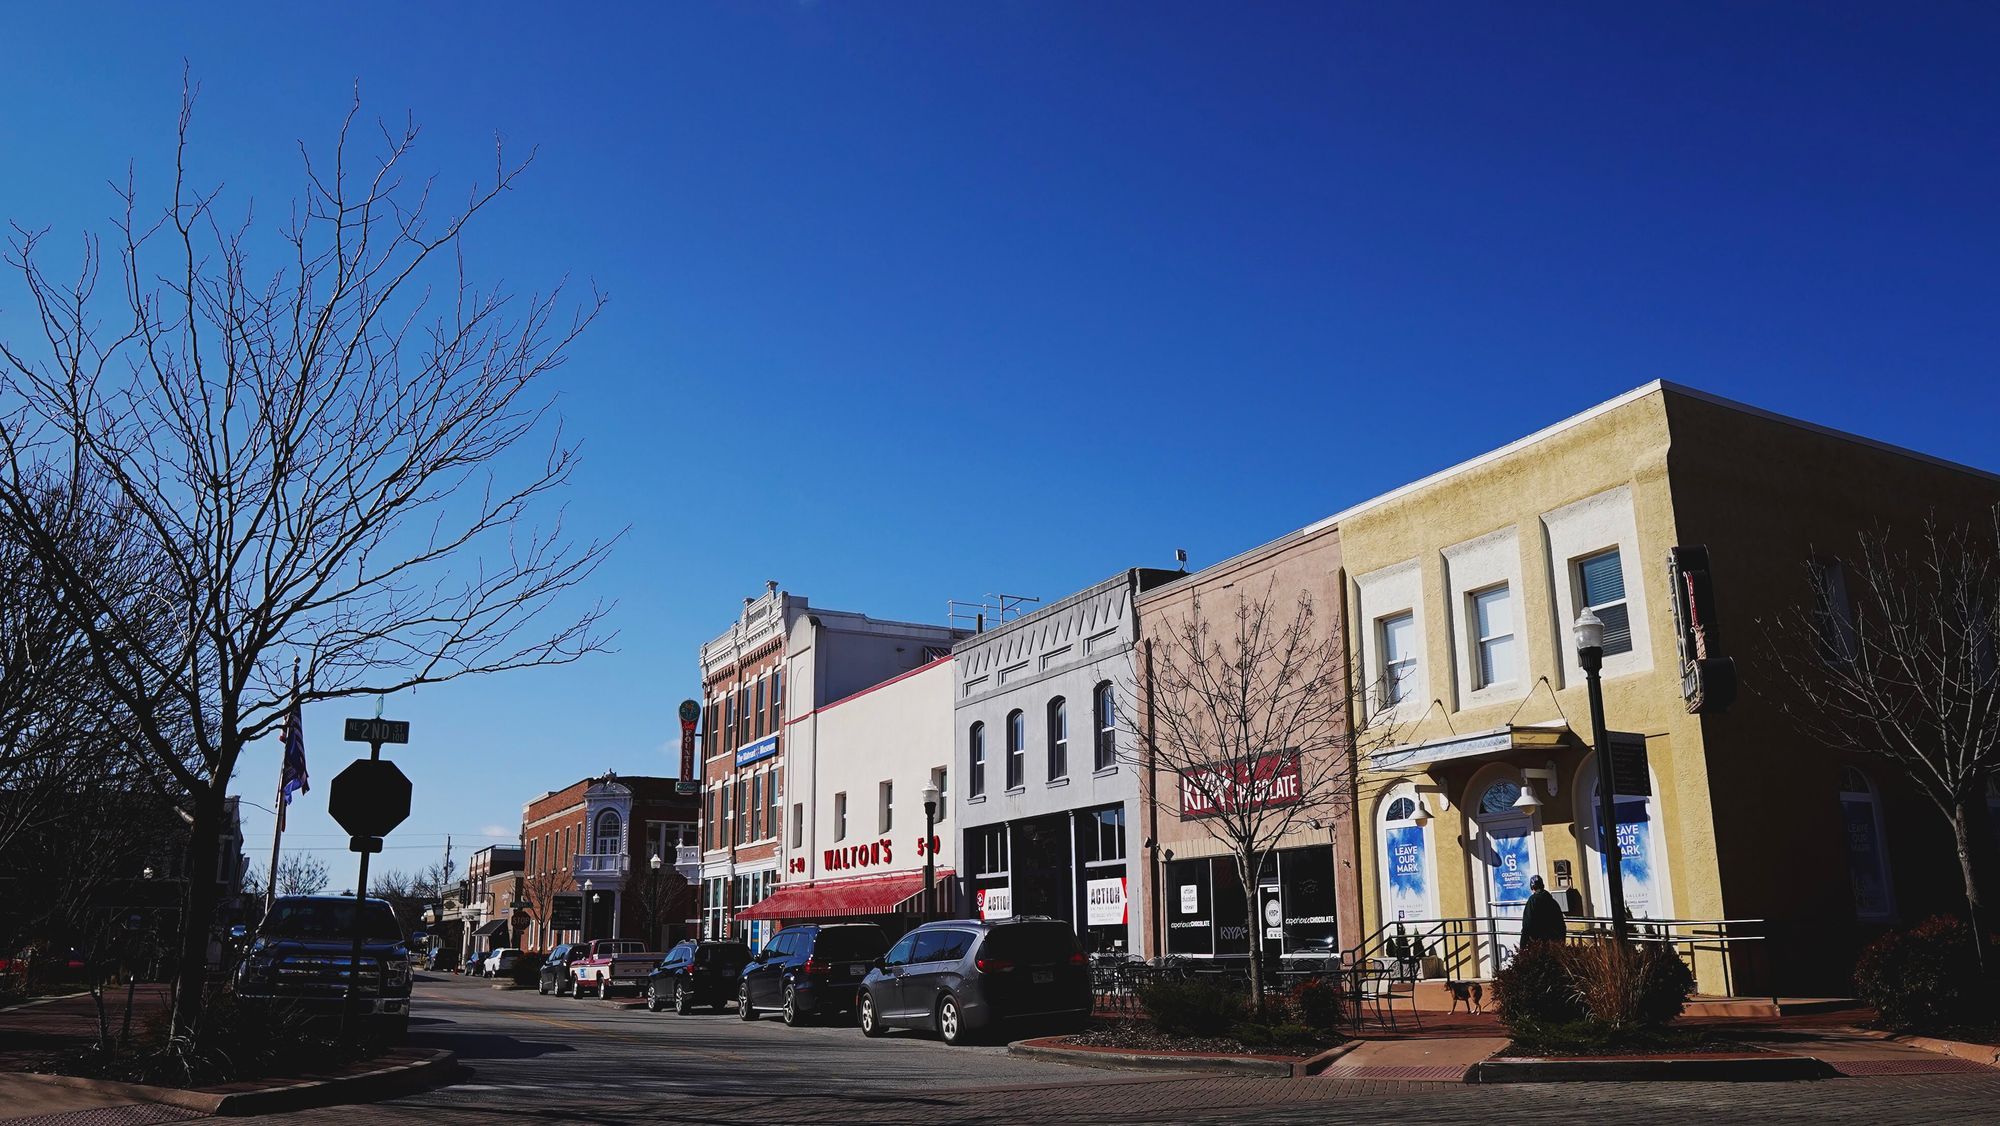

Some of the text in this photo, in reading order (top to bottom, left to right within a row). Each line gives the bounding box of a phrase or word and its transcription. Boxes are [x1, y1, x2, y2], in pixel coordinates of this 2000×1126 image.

[361, 722, 389, 739] 2ND
[1615, 824, 1639, 836] EAVE
[917, 835, 941, 857] 5-0
[1395, 846, 1418, 856] LEAVE
[1620, 845, 1641, 855] ARK
[824, 838, 893, 872] WALTON'S
[1399, 855, 1416, 864] OUR
[1396, 863, 1419, 873] MARK
[1090, 887, 1120, 905] ACTION
[512, 917, 529, 926] STOP
